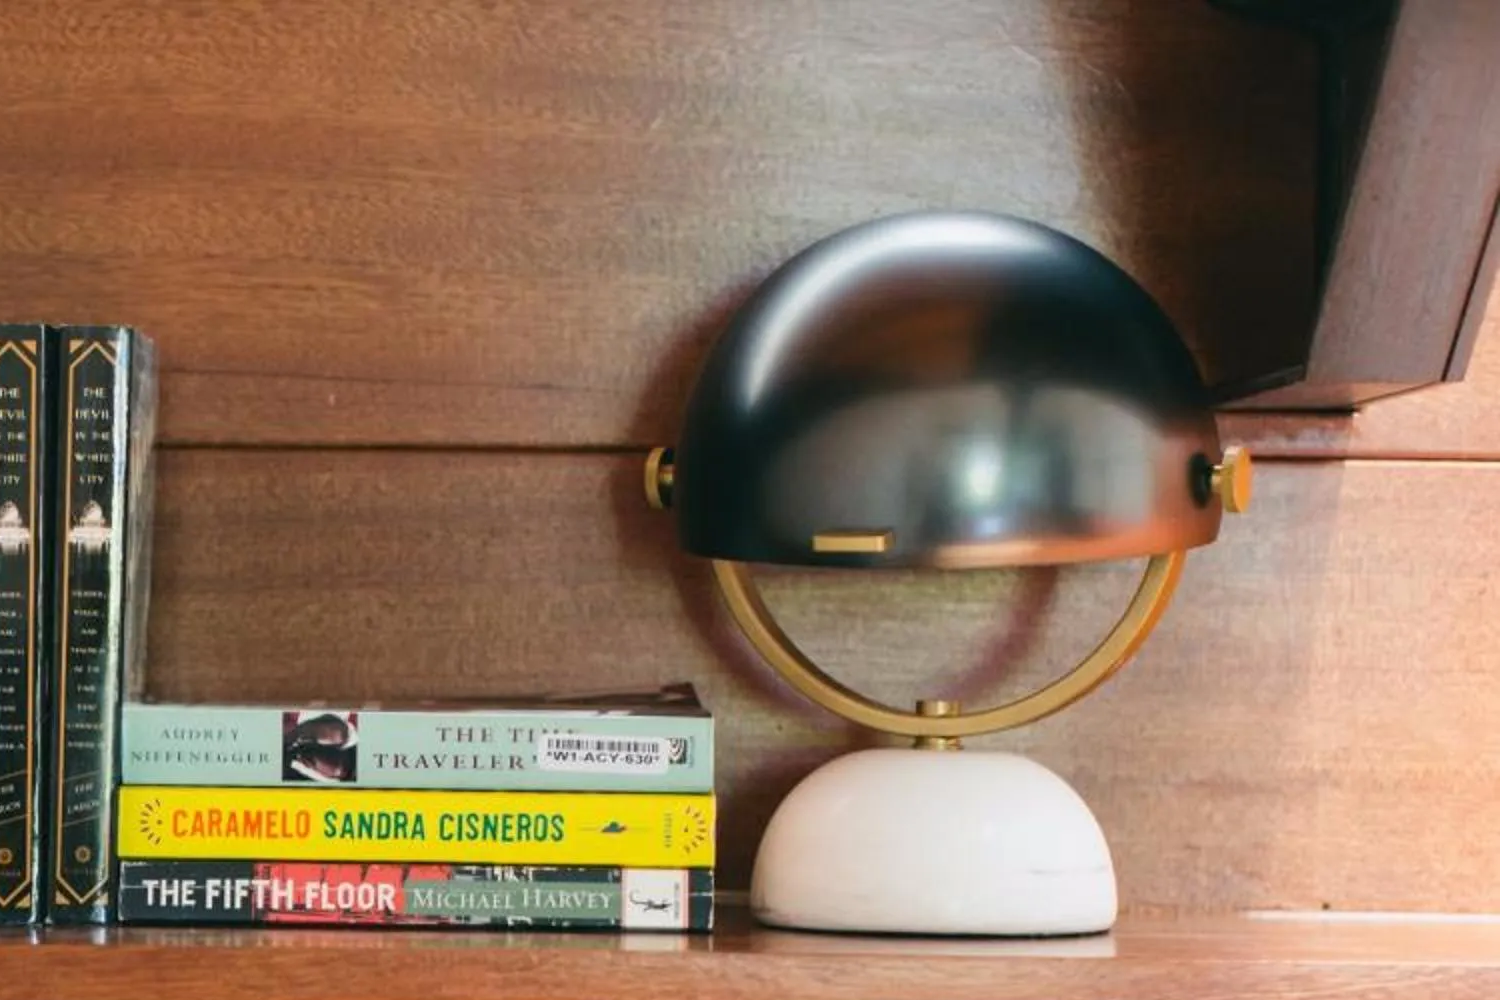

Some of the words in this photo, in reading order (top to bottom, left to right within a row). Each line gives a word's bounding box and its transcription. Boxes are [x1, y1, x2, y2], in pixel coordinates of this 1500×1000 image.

[75, 409, 110, 420] DEVIL
[160, 728, 240, 741] AUDREY
[436, 727, 494, 743] THE
[508, 728, 580, 744] TI
[130, 751, 271, 765] NIFFENEGGER
[373, 753, 538, 770] TRAVELER'
[171, 808, 313, 841] CARAMELO
[323, 810, 426, 842] SANDRA
[438, 811, 566, 843] CISNEROS
[141, 878, 198, 908] THE
[204, 878, 294, 911] FIFTH
[303, 882, 397, 912] FLOOR
[412, 887, 512, 911] MICHAEL
[522, 887, 615, 911] HARVEY
